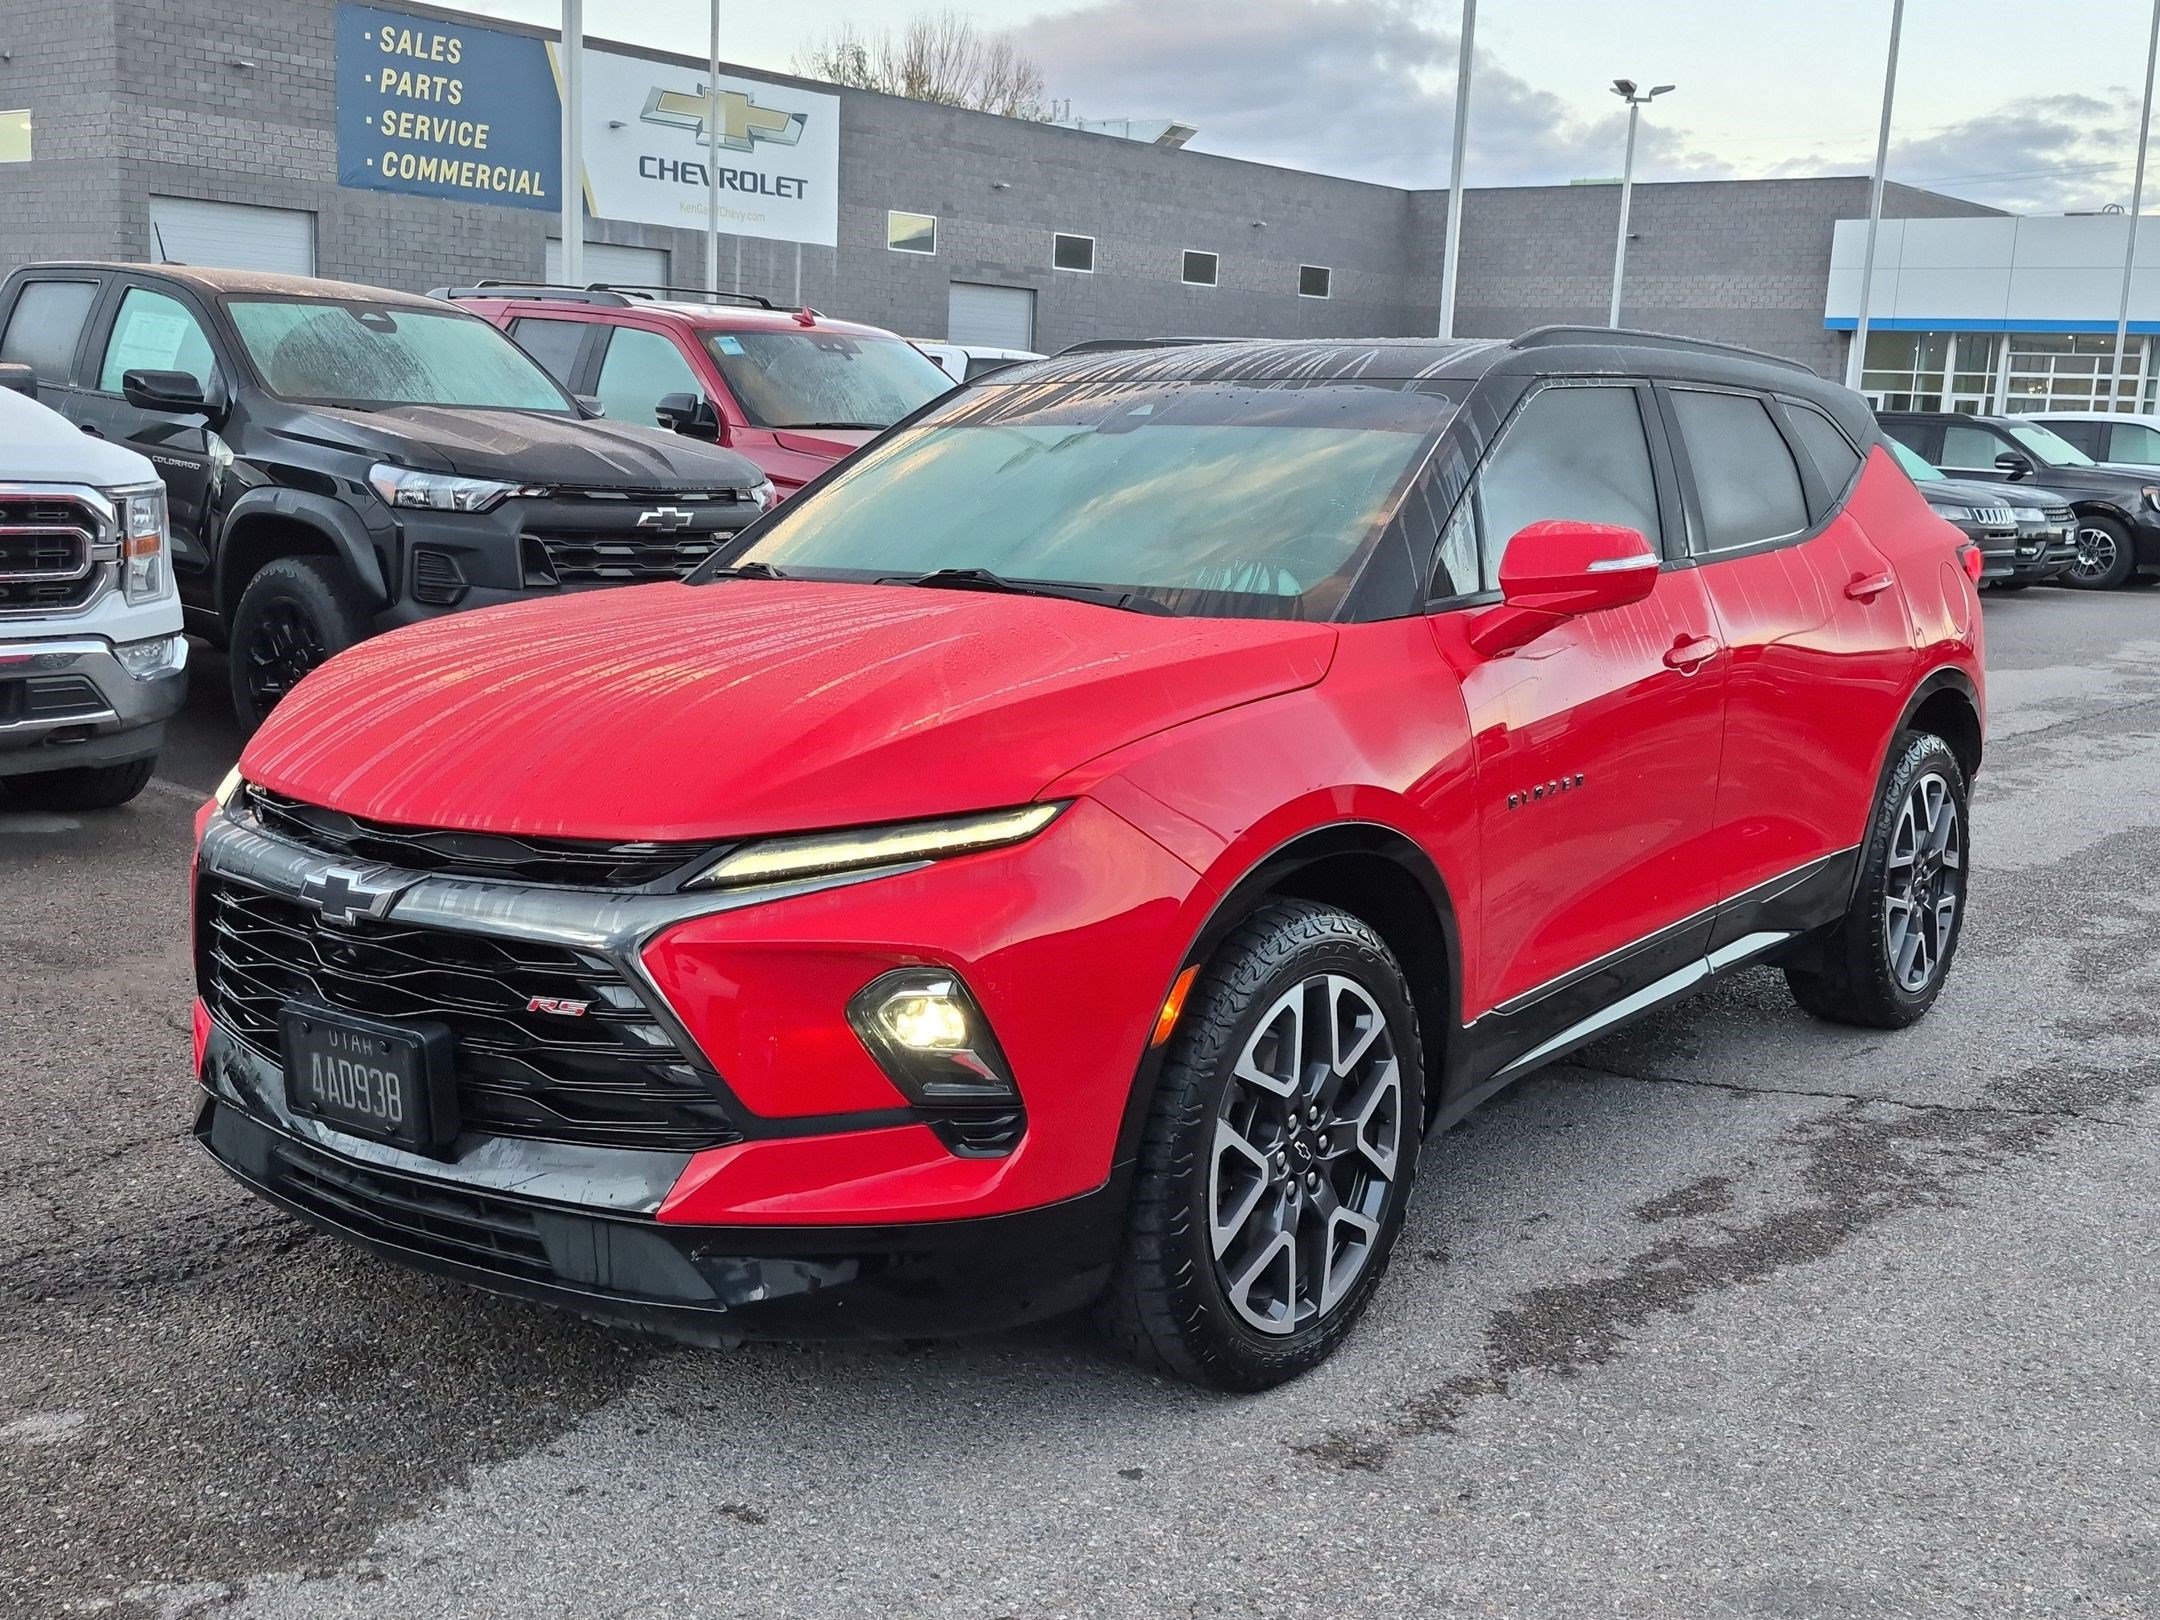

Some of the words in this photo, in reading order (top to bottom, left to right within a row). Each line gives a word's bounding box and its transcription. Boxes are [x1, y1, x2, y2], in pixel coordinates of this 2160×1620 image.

[379, 26, 462, 65] SALES
[380, 67, 463, 105] PARTS
[380, 109, 490, 150] SERVICE
[382, 151, 545, 197] COMMERCIAL
[639, 155, 809, 200] CHEVROLET
[1508, 773, 1584, 810] BLAZER
[526, 997, 588, 1017] RS
[328, 1030, 373, 1056] UTAH
